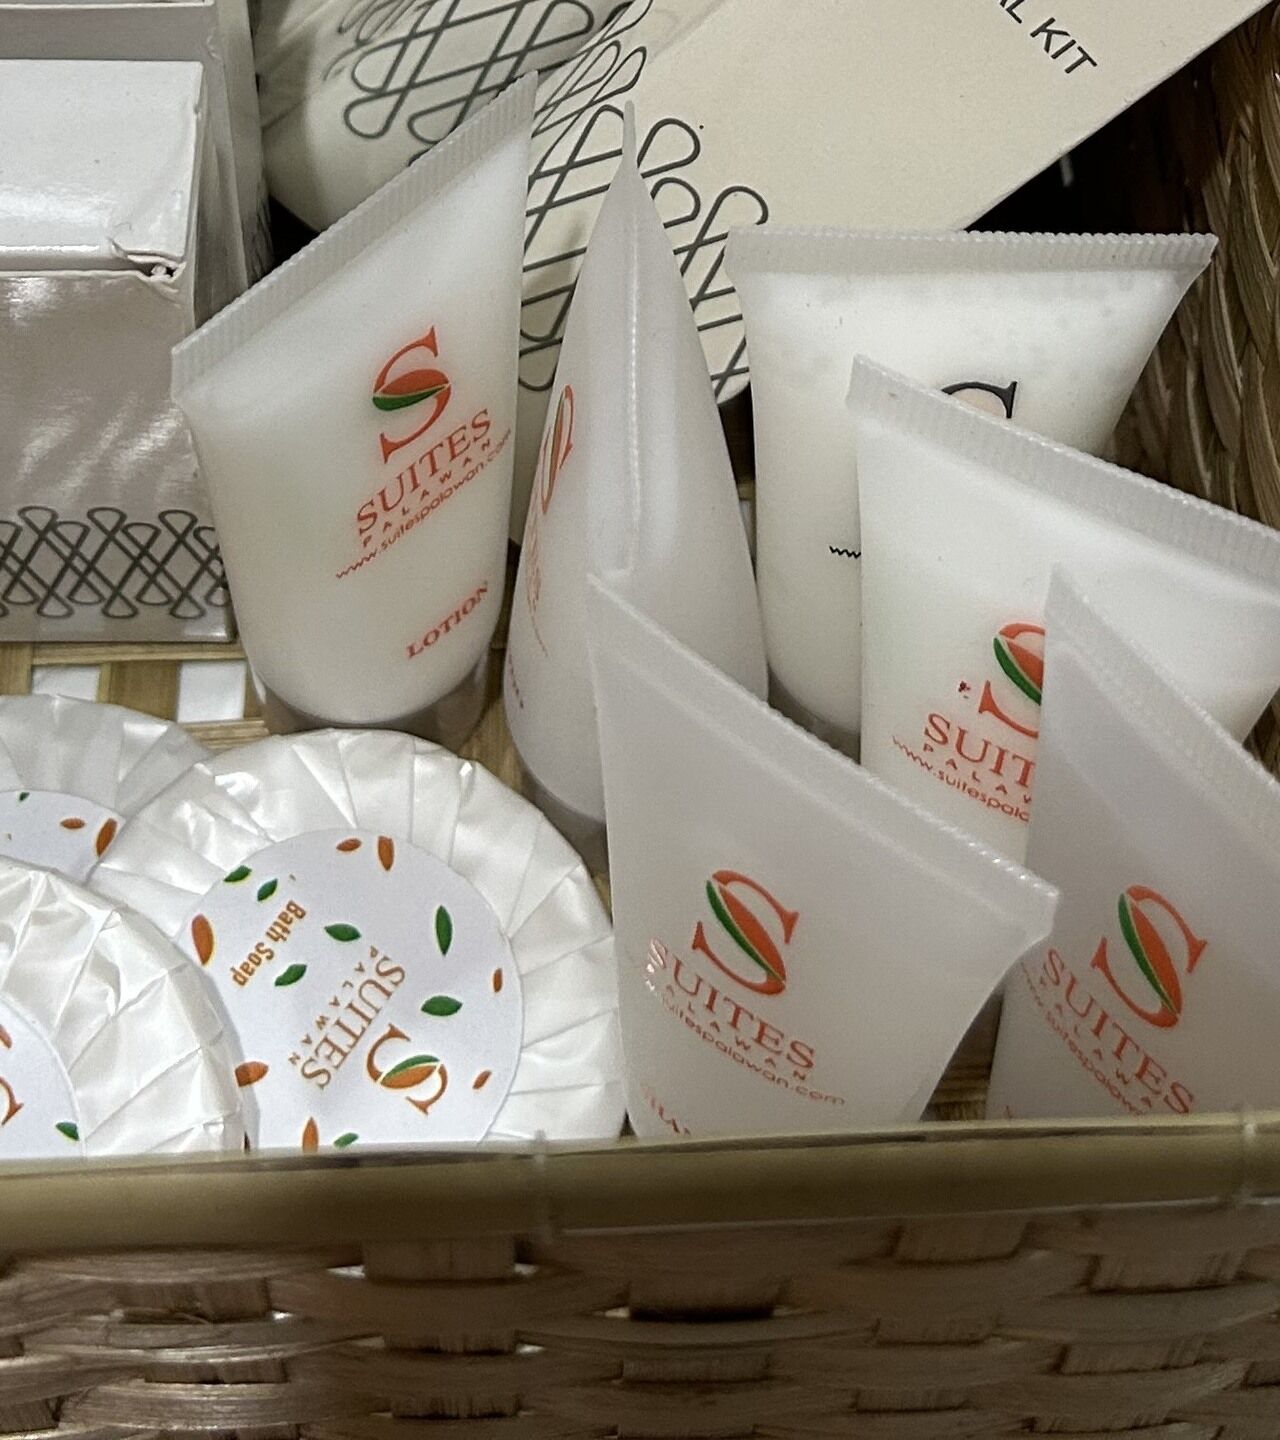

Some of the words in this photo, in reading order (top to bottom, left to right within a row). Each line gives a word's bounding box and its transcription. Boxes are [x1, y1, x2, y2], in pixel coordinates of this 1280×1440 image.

[1029, 17, 1098, 74] KIT
[356, 408, 492, 536] SUITES
[363, 438, 491, 549] PALAWAN
[407, 581, 488, 659] LOTION
[230, 942, 275, 986] Soap
[265, 900, 307, 943] Bath
[288, 945, 380, 1066] PALAWAN
[300, 954, 407, 1090] SUITES
[646, 962, 808, 1082] ALAWAN
[1042, 948, 1195, 1115] SUITES
